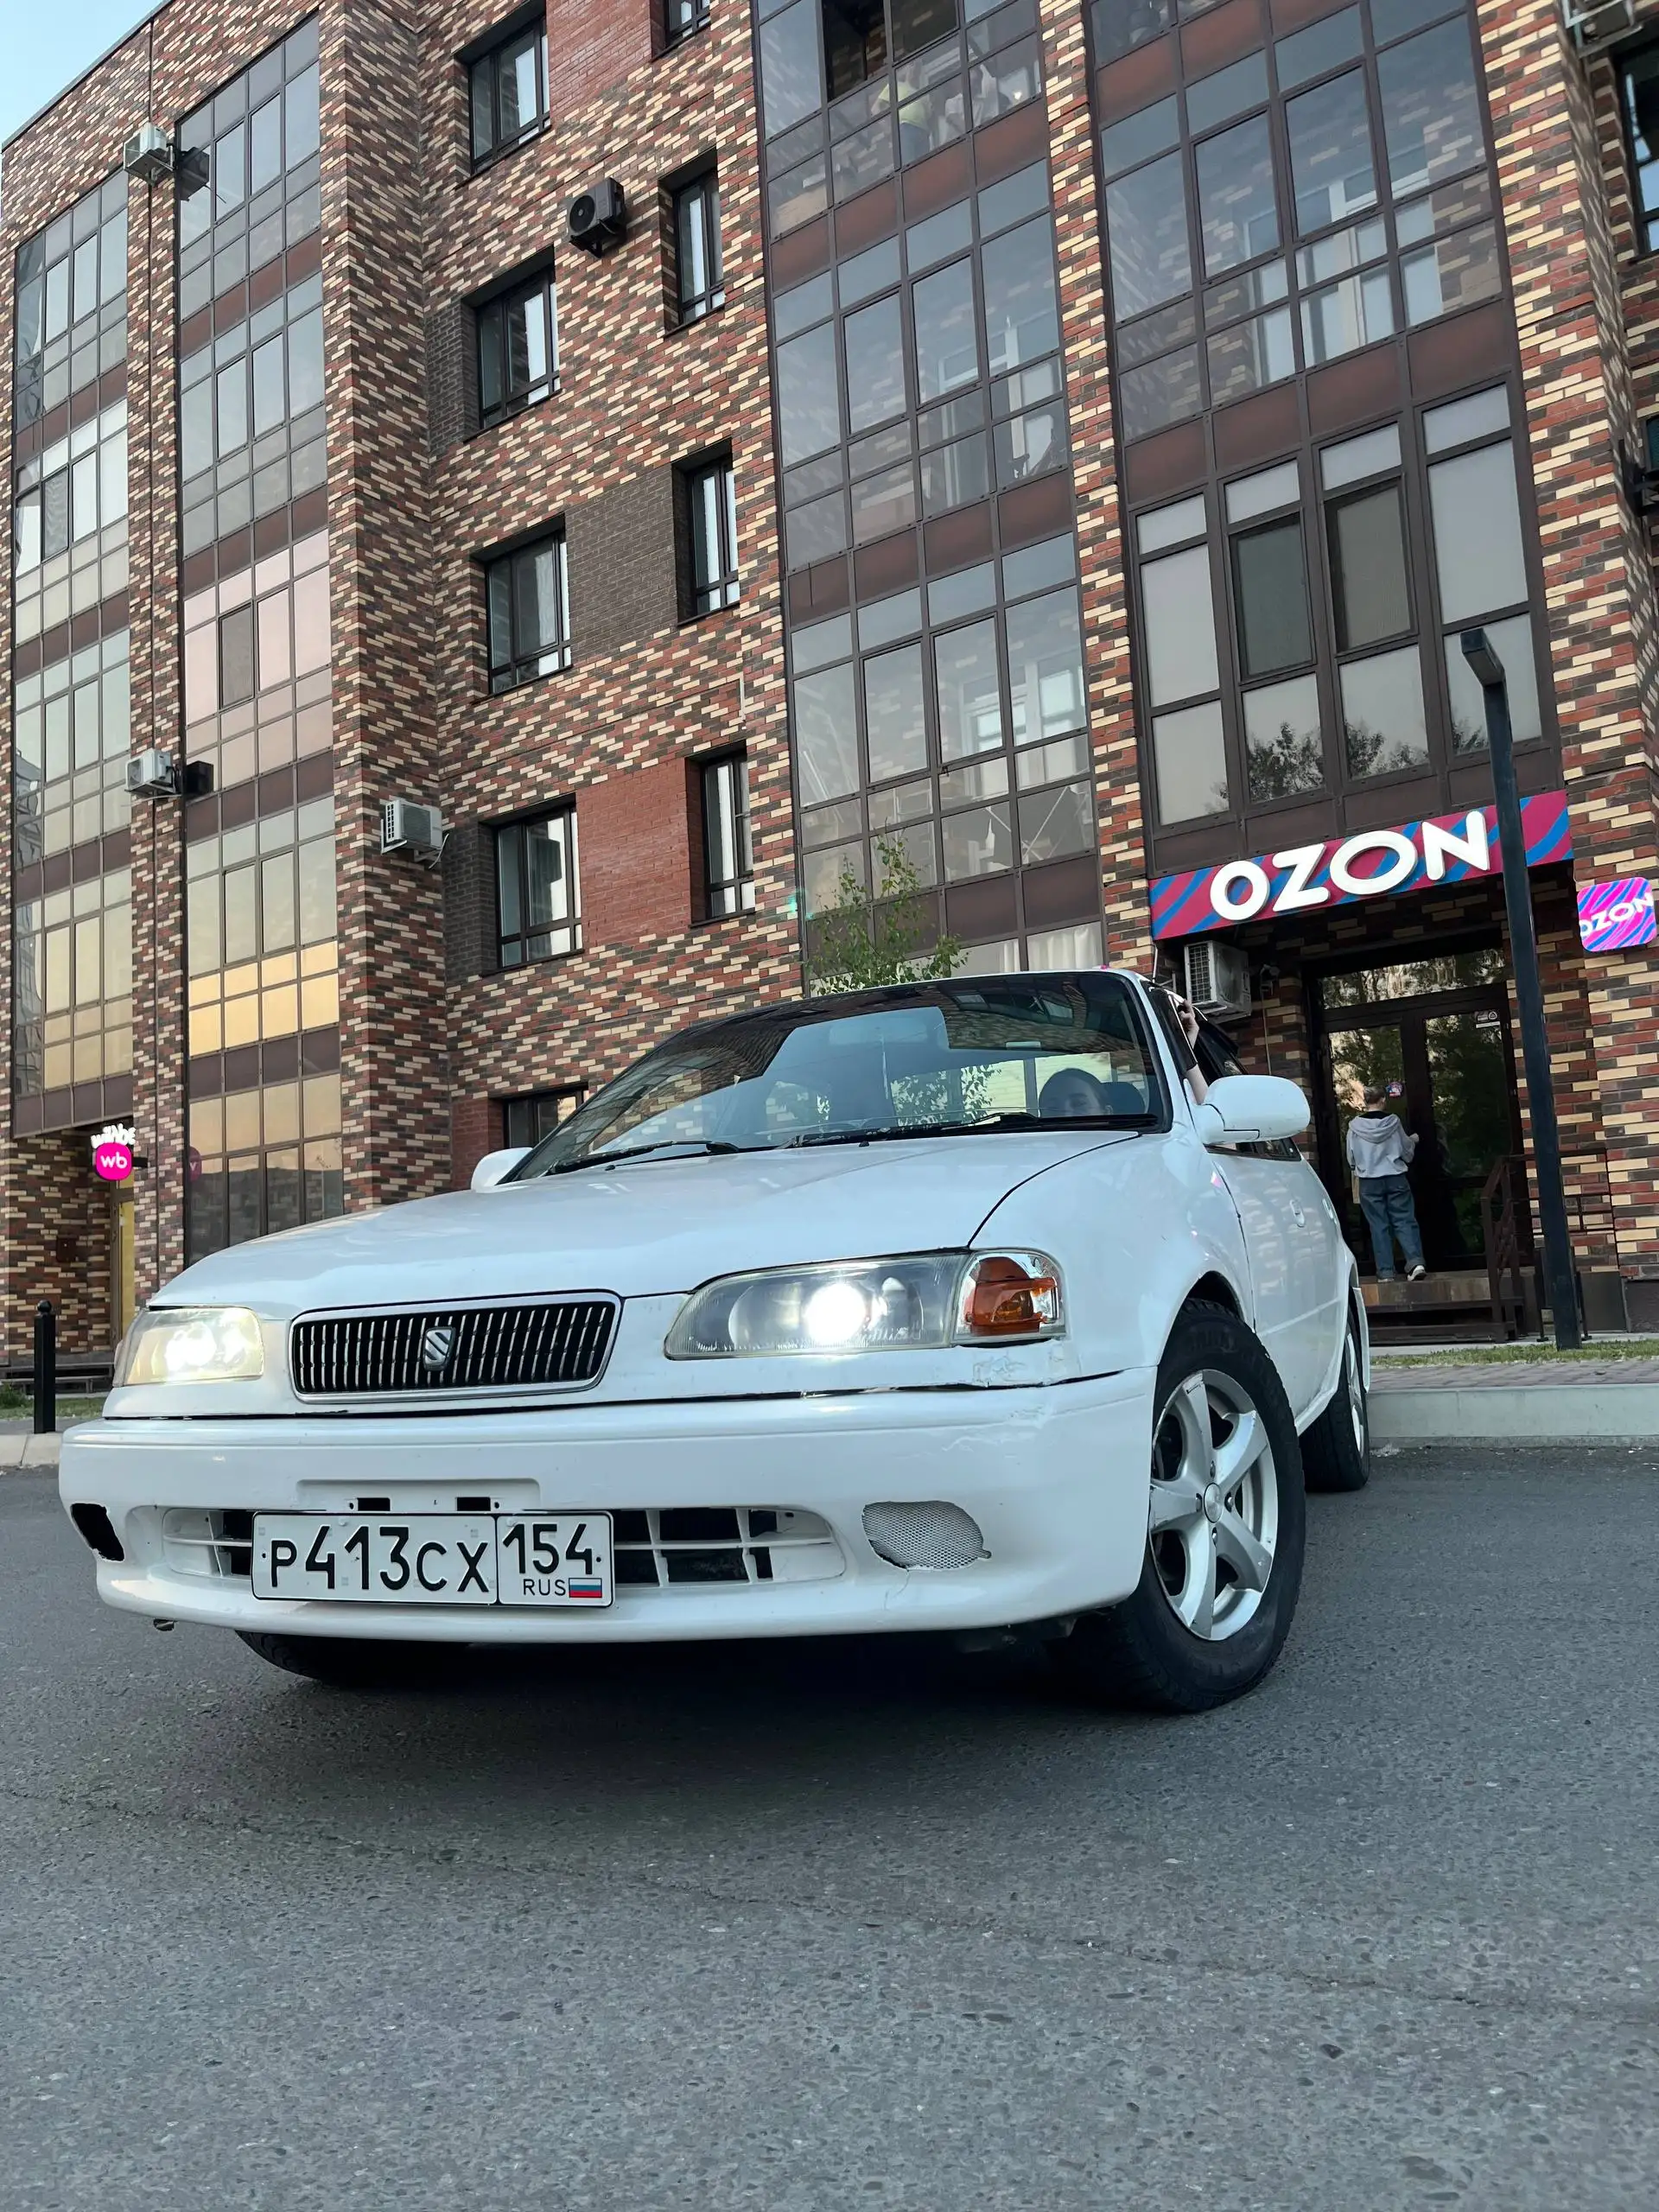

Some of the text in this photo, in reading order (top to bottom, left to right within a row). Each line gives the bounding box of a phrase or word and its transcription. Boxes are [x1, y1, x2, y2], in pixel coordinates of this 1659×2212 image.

[1210, 810, 1491, 921] OZON
[1579, 893, 1654, 938] OZON
[100, 1151, 128, 1169] wb
[502, 1523, 593, 1575] 154
[522, 1579, 566, 1598] RUS
